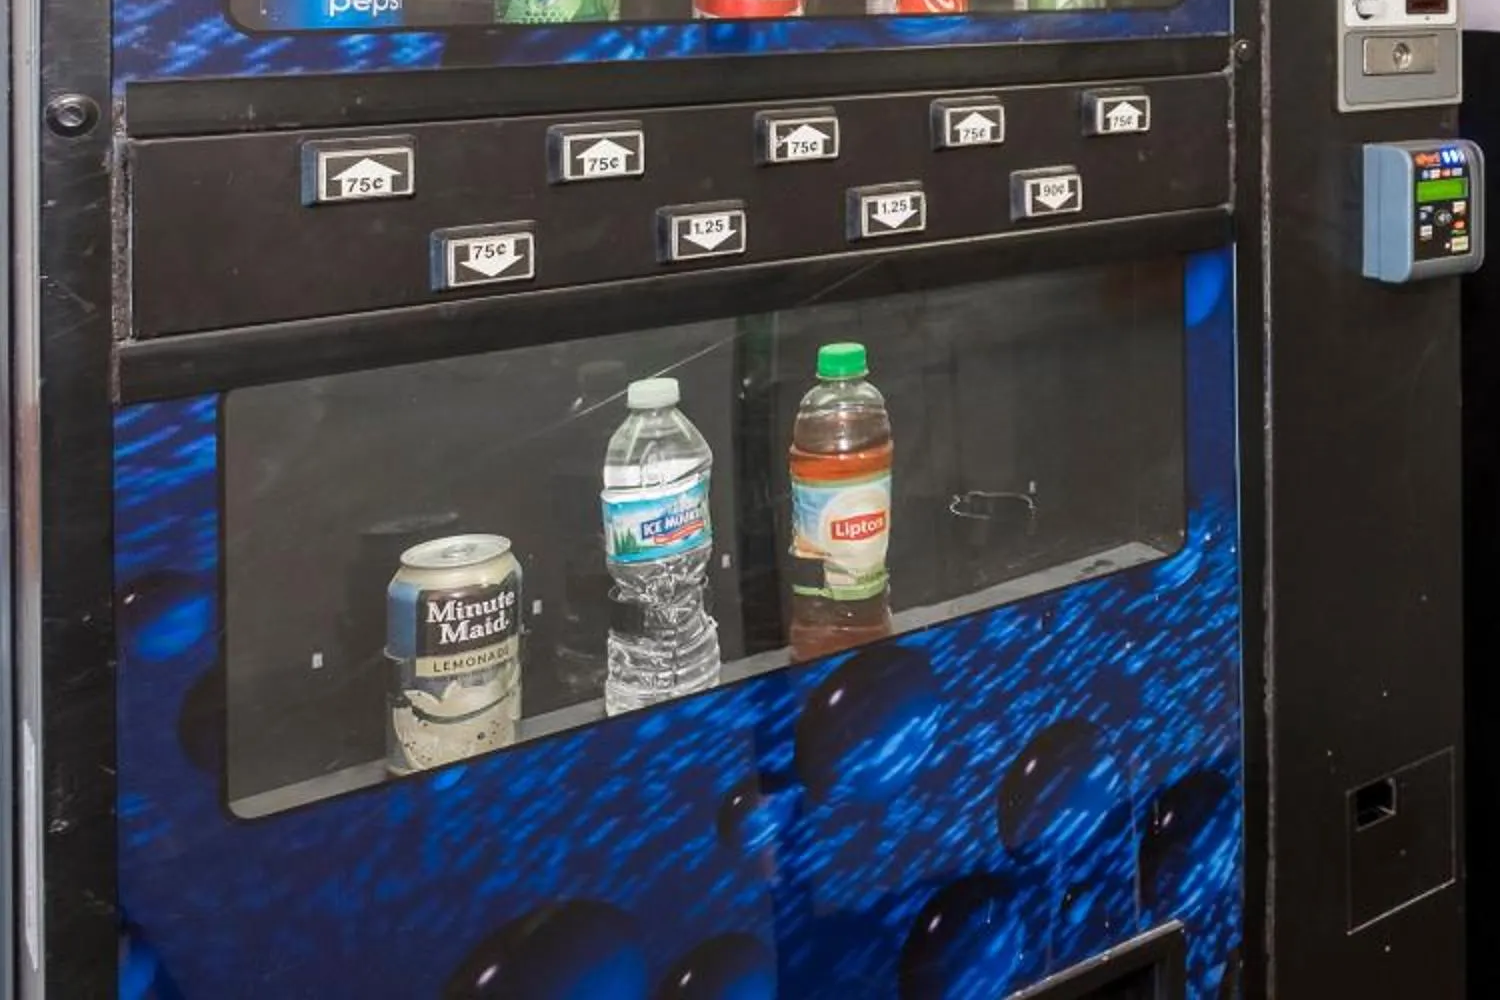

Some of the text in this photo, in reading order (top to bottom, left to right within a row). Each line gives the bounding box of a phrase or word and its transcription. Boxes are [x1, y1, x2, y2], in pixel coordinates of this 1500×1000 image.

[791, 141, 818, 154] 75¢
[588, 156, 620, 172] 75¢
[346, 176, 384, 194] 75¢
[473, 242, 507, 260] 75¢
[425, 591, 515, 623] Minute
[438, 610, 508, 645] Maid
